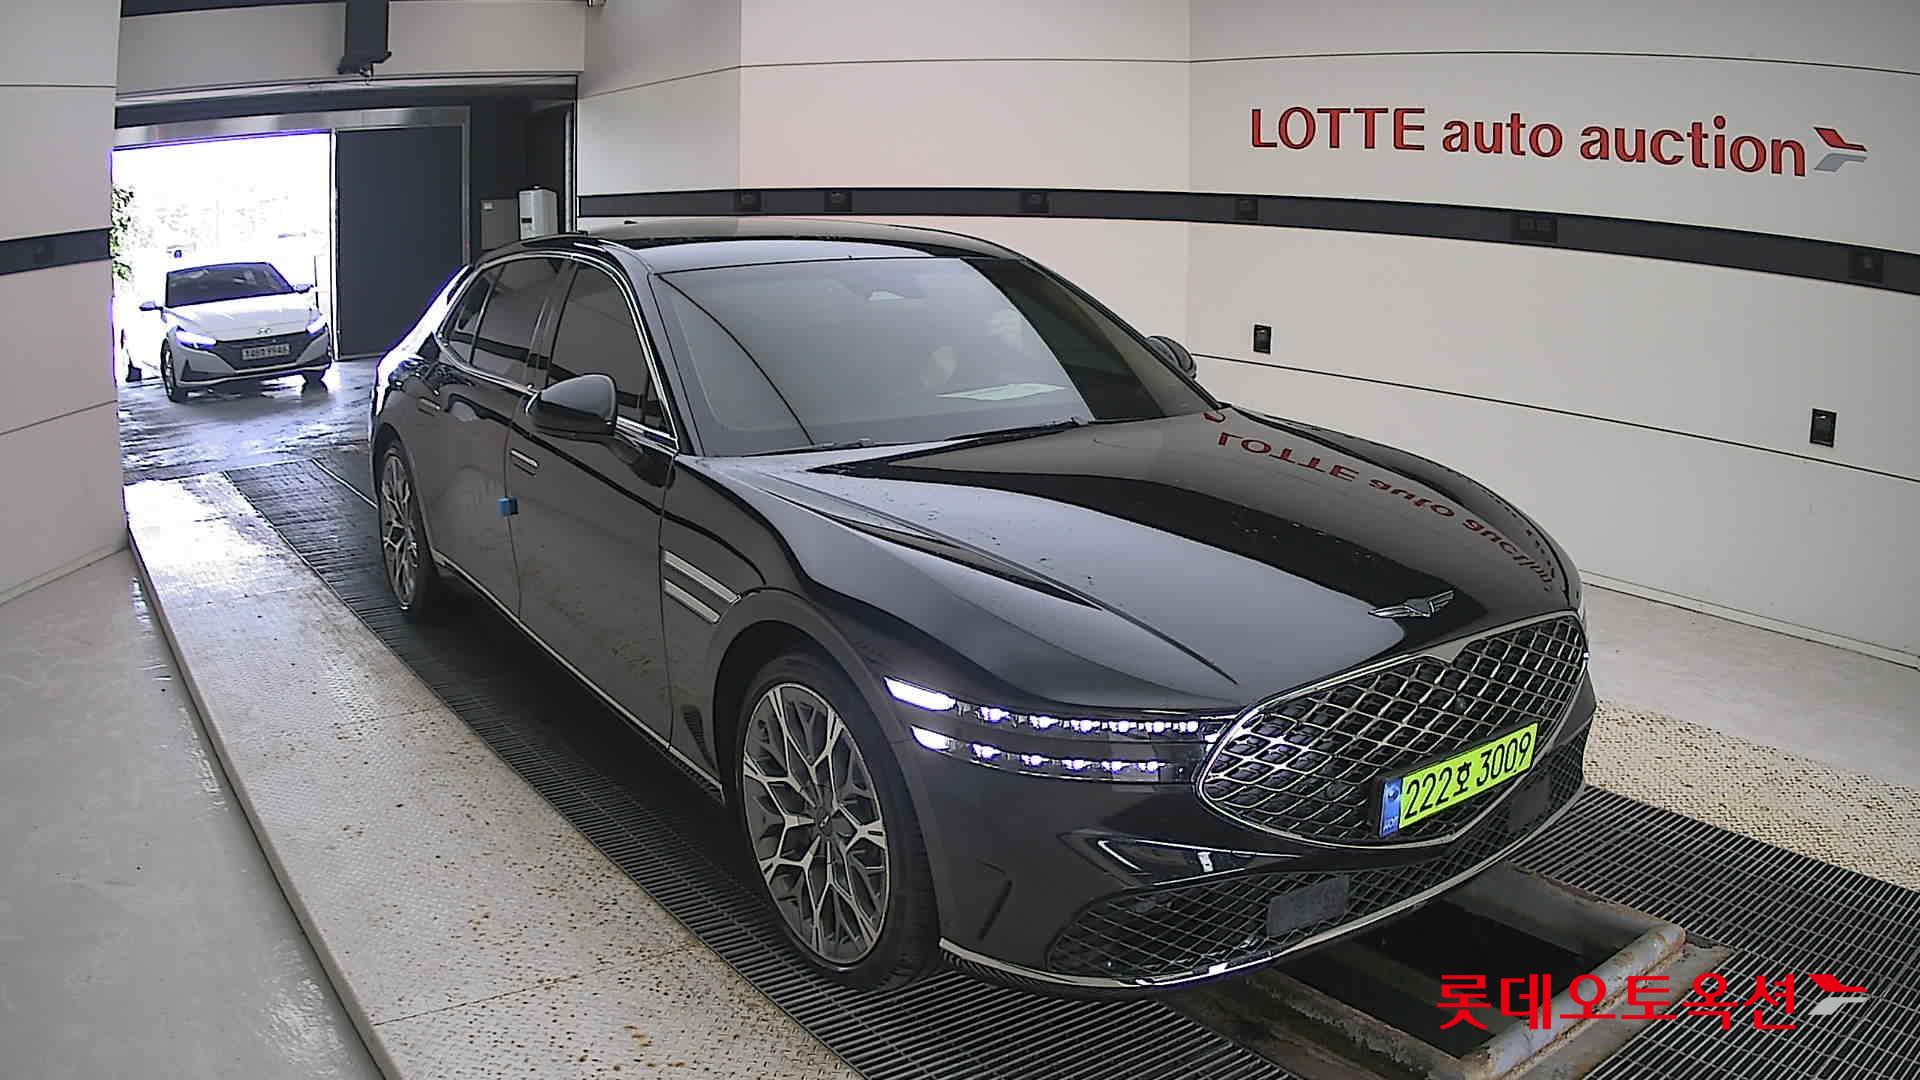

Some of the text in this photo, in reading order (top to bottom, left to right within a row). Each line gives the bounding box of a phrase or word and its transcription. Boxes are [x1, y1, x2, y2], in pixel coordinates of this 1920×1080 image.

[1251, 107, 1807, 177] LOTTE auto auction
[1404, 732, 1532, 820] 222호 3009
